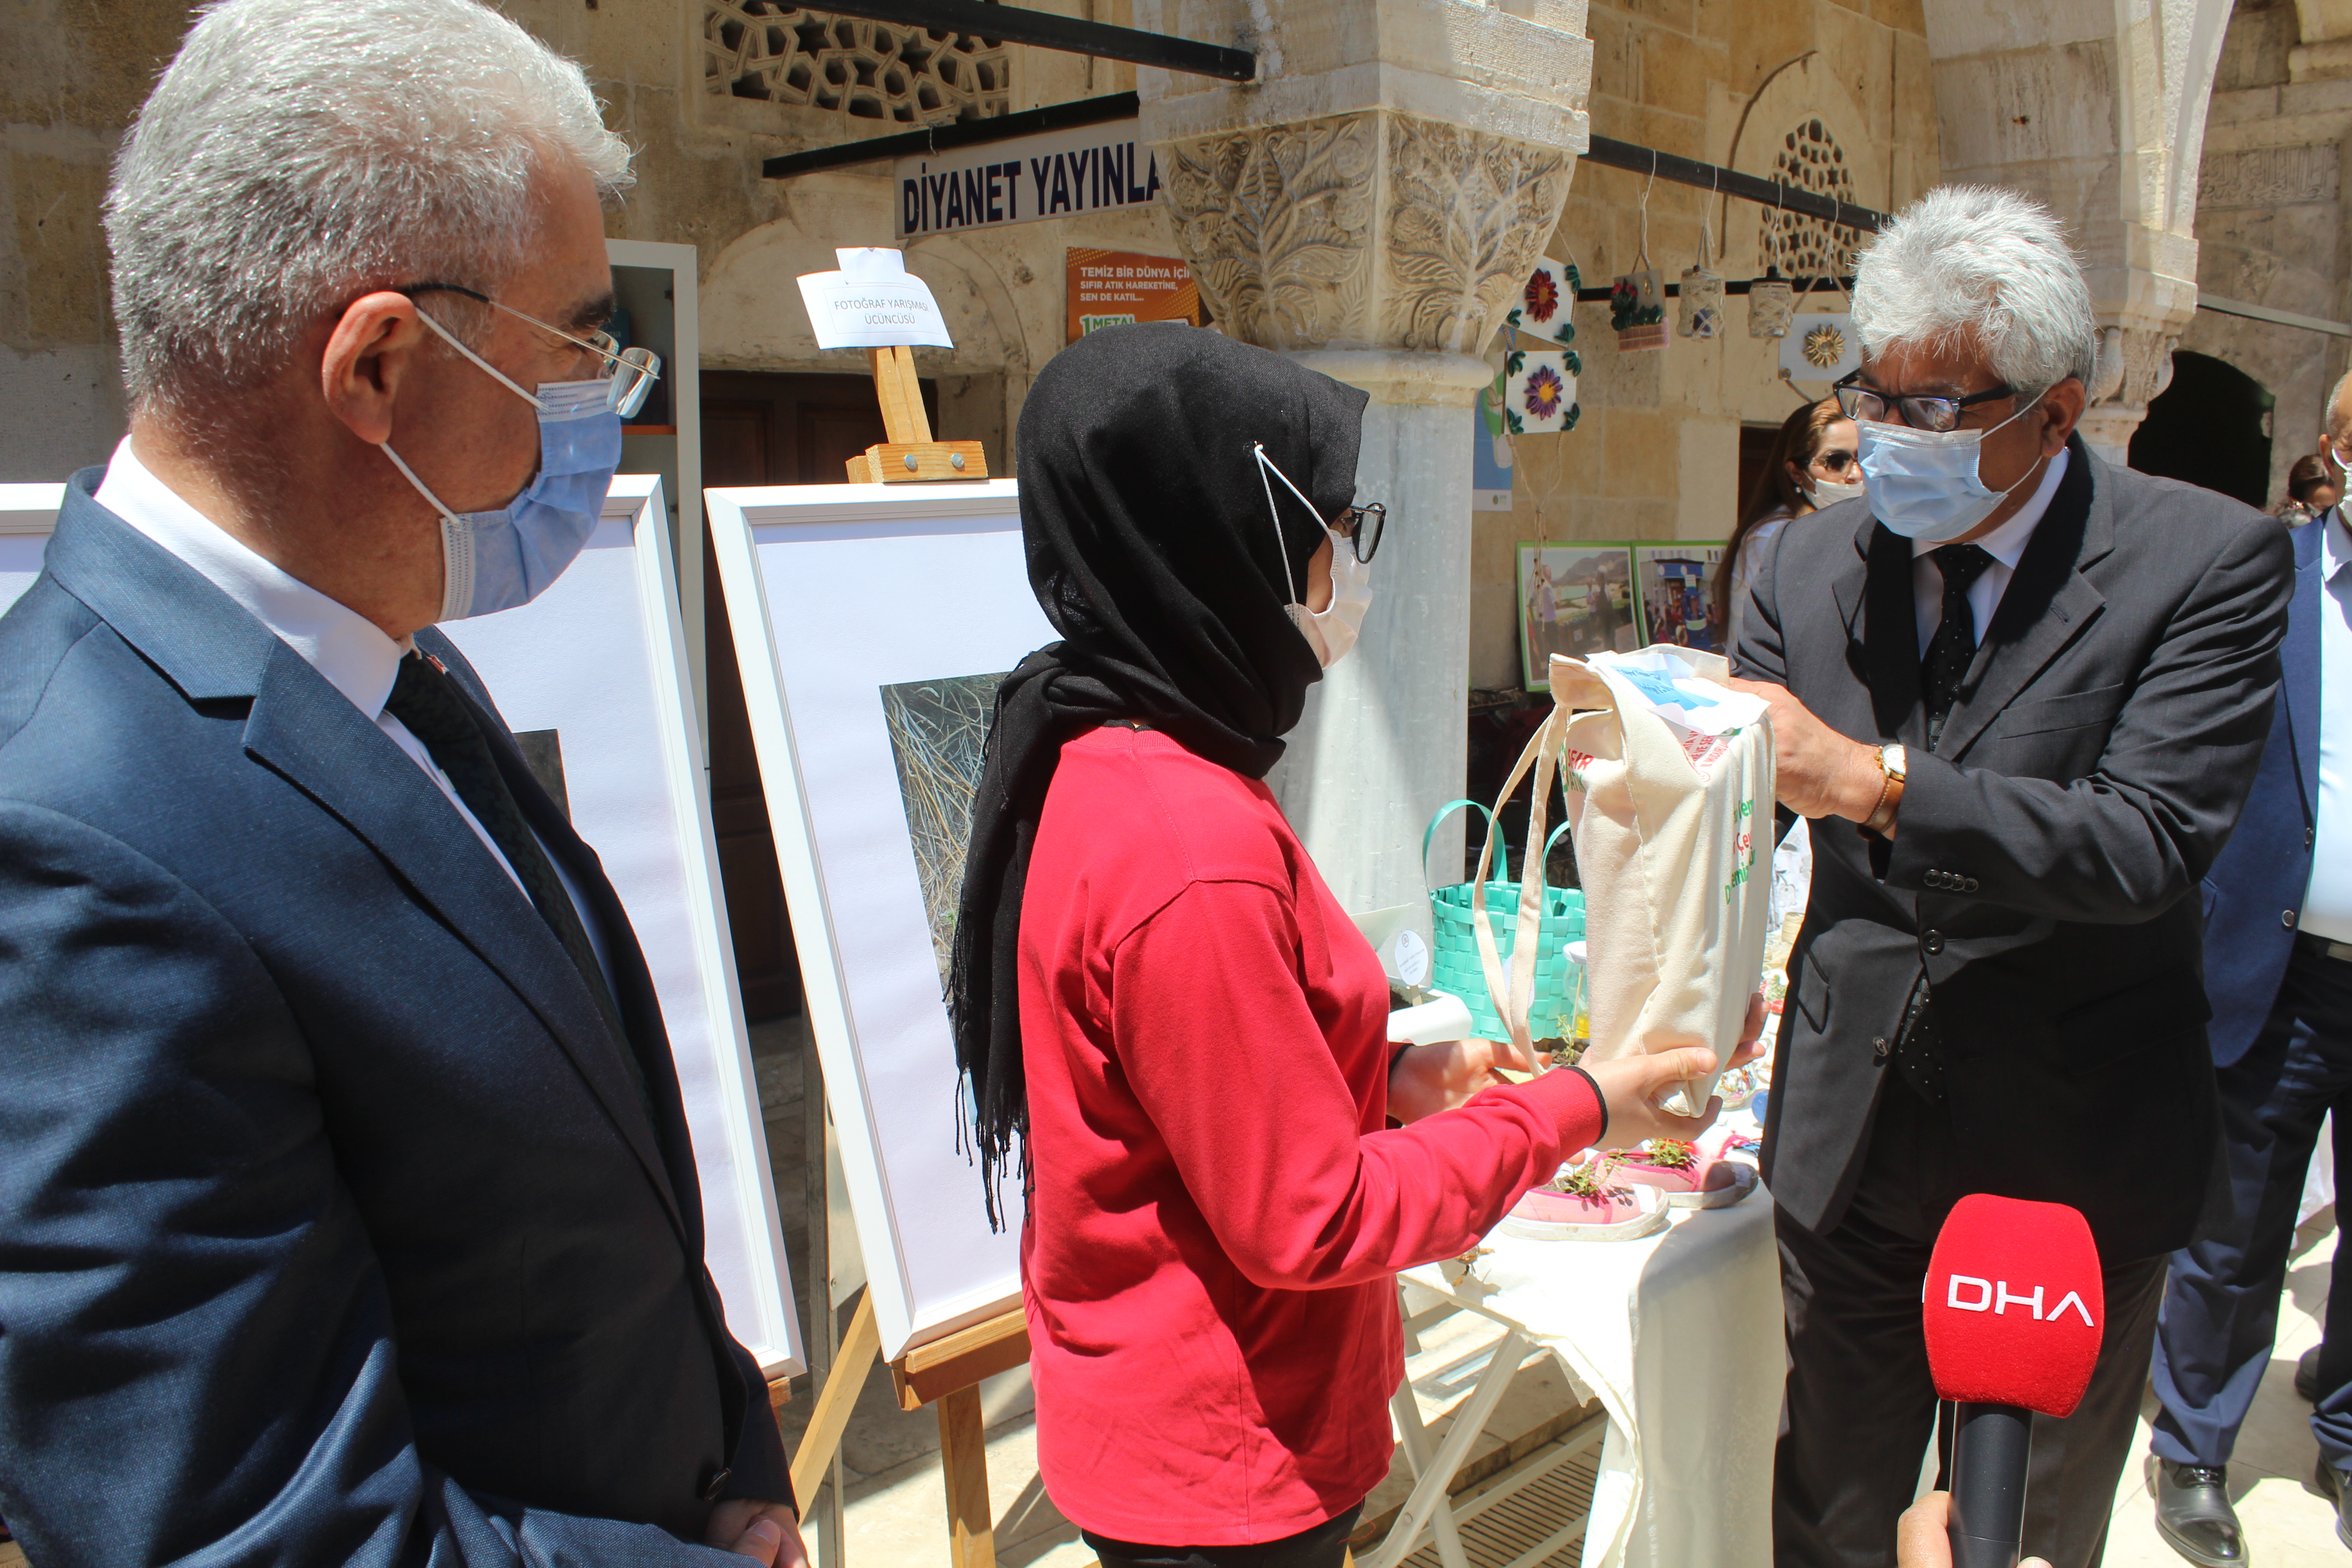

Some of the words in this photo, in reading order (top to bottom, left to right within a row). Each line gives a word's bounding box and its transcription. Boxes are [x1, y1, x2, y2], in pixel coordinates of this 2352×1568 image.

[903, 161, 1021, 234] DİYANET
[1081, 265, 1113, 278] TEMİZ
[1117, 265, 1134, 278] BİR
[1137, 266, 1171, 278] DÜNYA
[1080, 281, 1103, 289] SIFIR
[1126, 280, 1178, 291] HAREKETİNE,
[1080, 293, 1098, 301] SEN
[1114, 293, 1144, 301] KATIL...
[834, 297, 886, 310] FOTOĞRAF
[887, 299, 929, 312] YARIŞMASI
[1947, 1274, 2095, 1327] DHA
